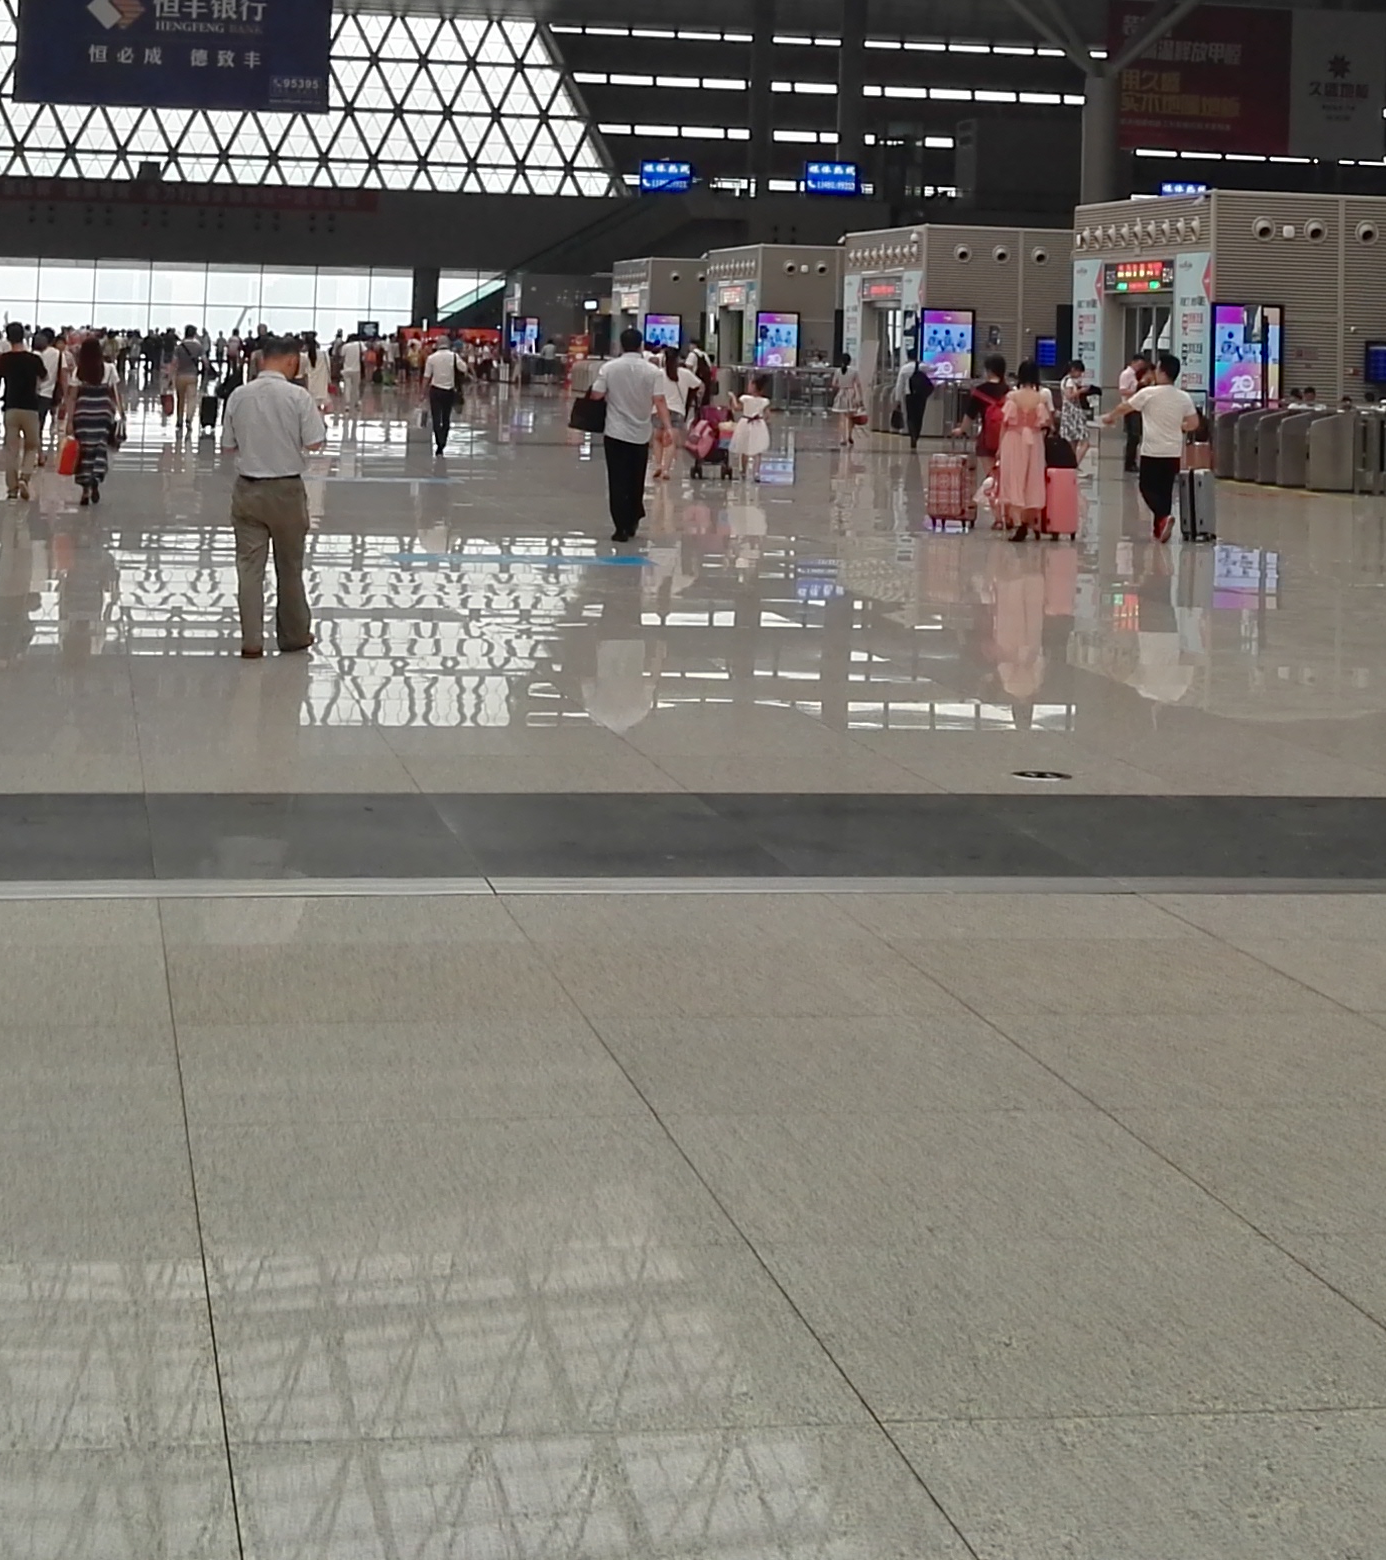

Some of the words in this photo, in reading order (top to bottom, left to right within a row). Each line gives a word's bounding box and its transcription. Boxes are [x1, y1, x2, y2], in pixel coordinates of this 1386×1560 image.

[155, 20, 225, 34] HENGFENG
[88, 44, 163, 66] 恒必成
[190, 48, 262, 70] 德致丰
